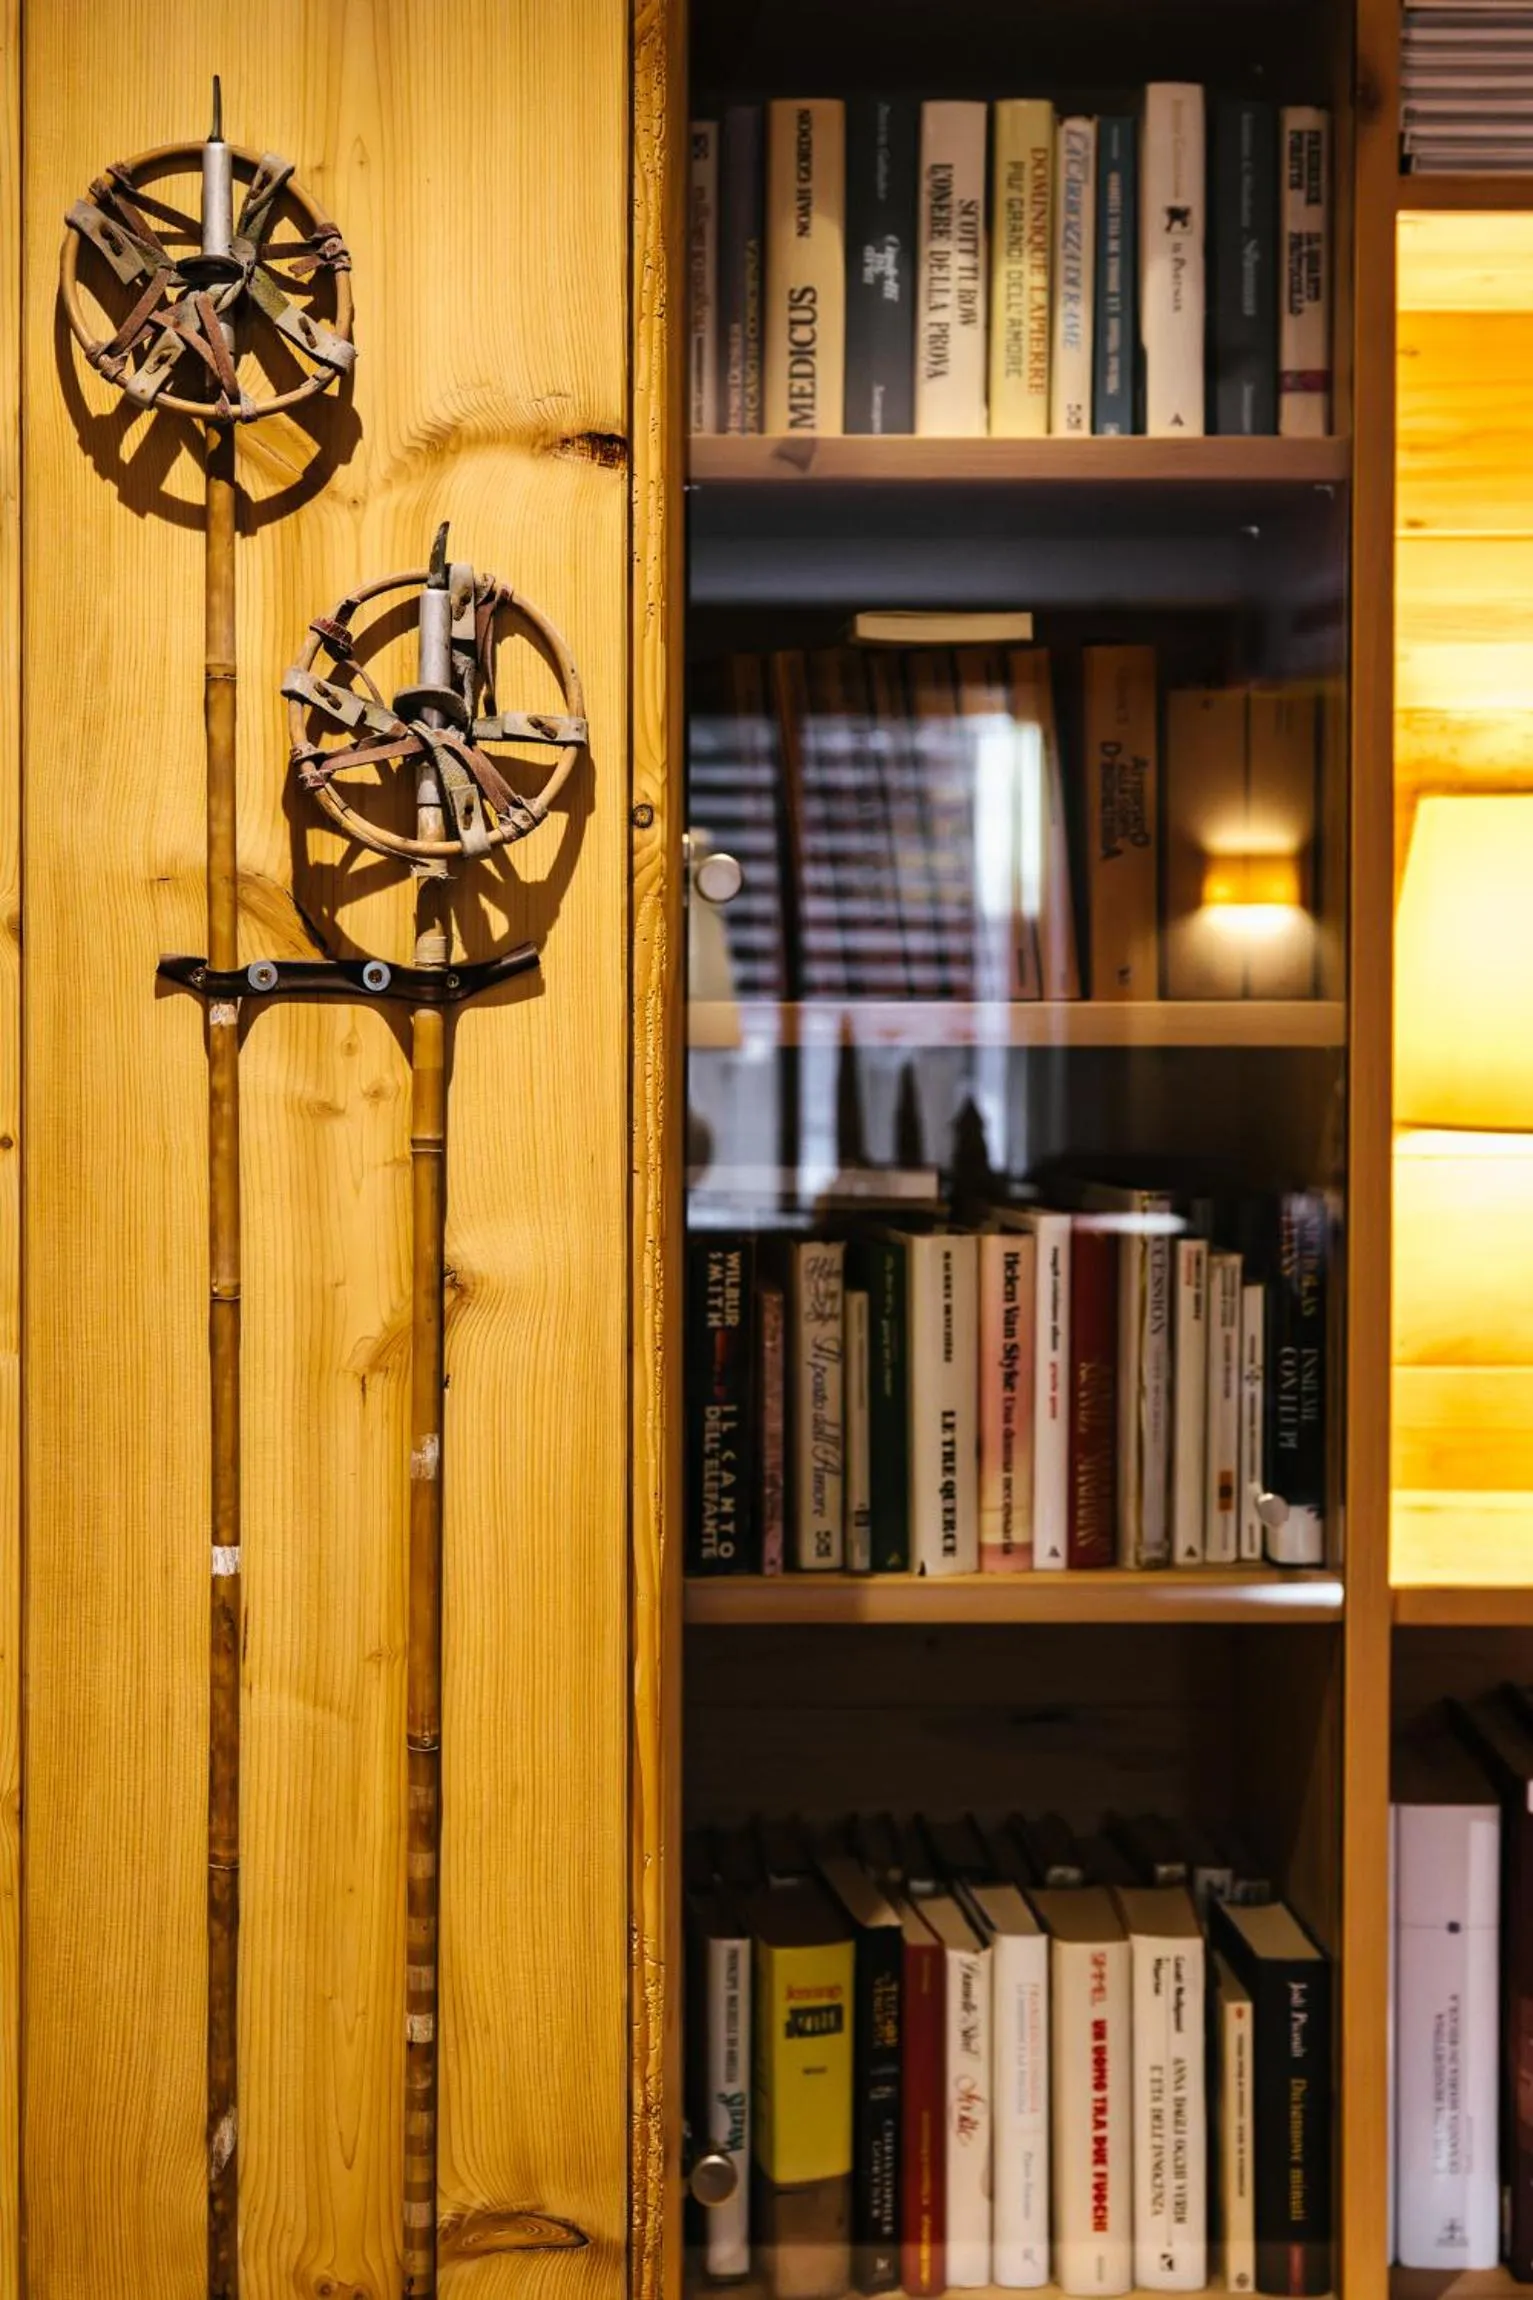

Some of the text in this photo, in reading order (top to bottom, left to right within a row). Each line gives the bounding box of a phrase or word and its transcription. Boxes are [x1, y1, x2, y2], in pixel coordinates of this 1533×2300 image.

[796, 108, 812, 238] NOAH GORDON
[957, 199, 979, 329] SCOTT TUROW
[1005, 197, 1024, 264] GRANDI
[926, 163, 953, 379] L'ONERE DELLA PROVA
[1028, 147, 1049, 395] DOMINIQUE LAPIERRE
[787, 286, 817, 430] MEDICUS
[706, 1251, 724, 1328] SMITH
[725, 1251, 741, 1327] WILBUR
[1004, 1251, 1020, 1303] Helen
[1004, 1305, 1020, 1339] Van
[999, 1342, 1021, 1393] Slyke
[1279, 1346, 1299, 1390] CON
[701, 1405, 720, 1559] DELL'ELEFANTE
[719, 1404, 738, 1559] IL CANTO
[939, 1410, 956, 1557] LE TRE QUERCE
[1003, 1428, 1015, 1473] donna
[1092, 2019, 1108, 2041] UN
[1288, 1981, 1309, 2059] Jodi Picoult
[1092, 2046, 1109, 2092] UOMO
[1092, 2097, 1108, 2131] TRA
[1173, 2057, 1188, 2225] ANNA DAGLI OCCHI VERDI
[1092, 2136, 1108, 2166] DUE
[1091, 2172, 1108, 2233] FUOCHI
[1289, 2168, 1309, 2221] minuti
